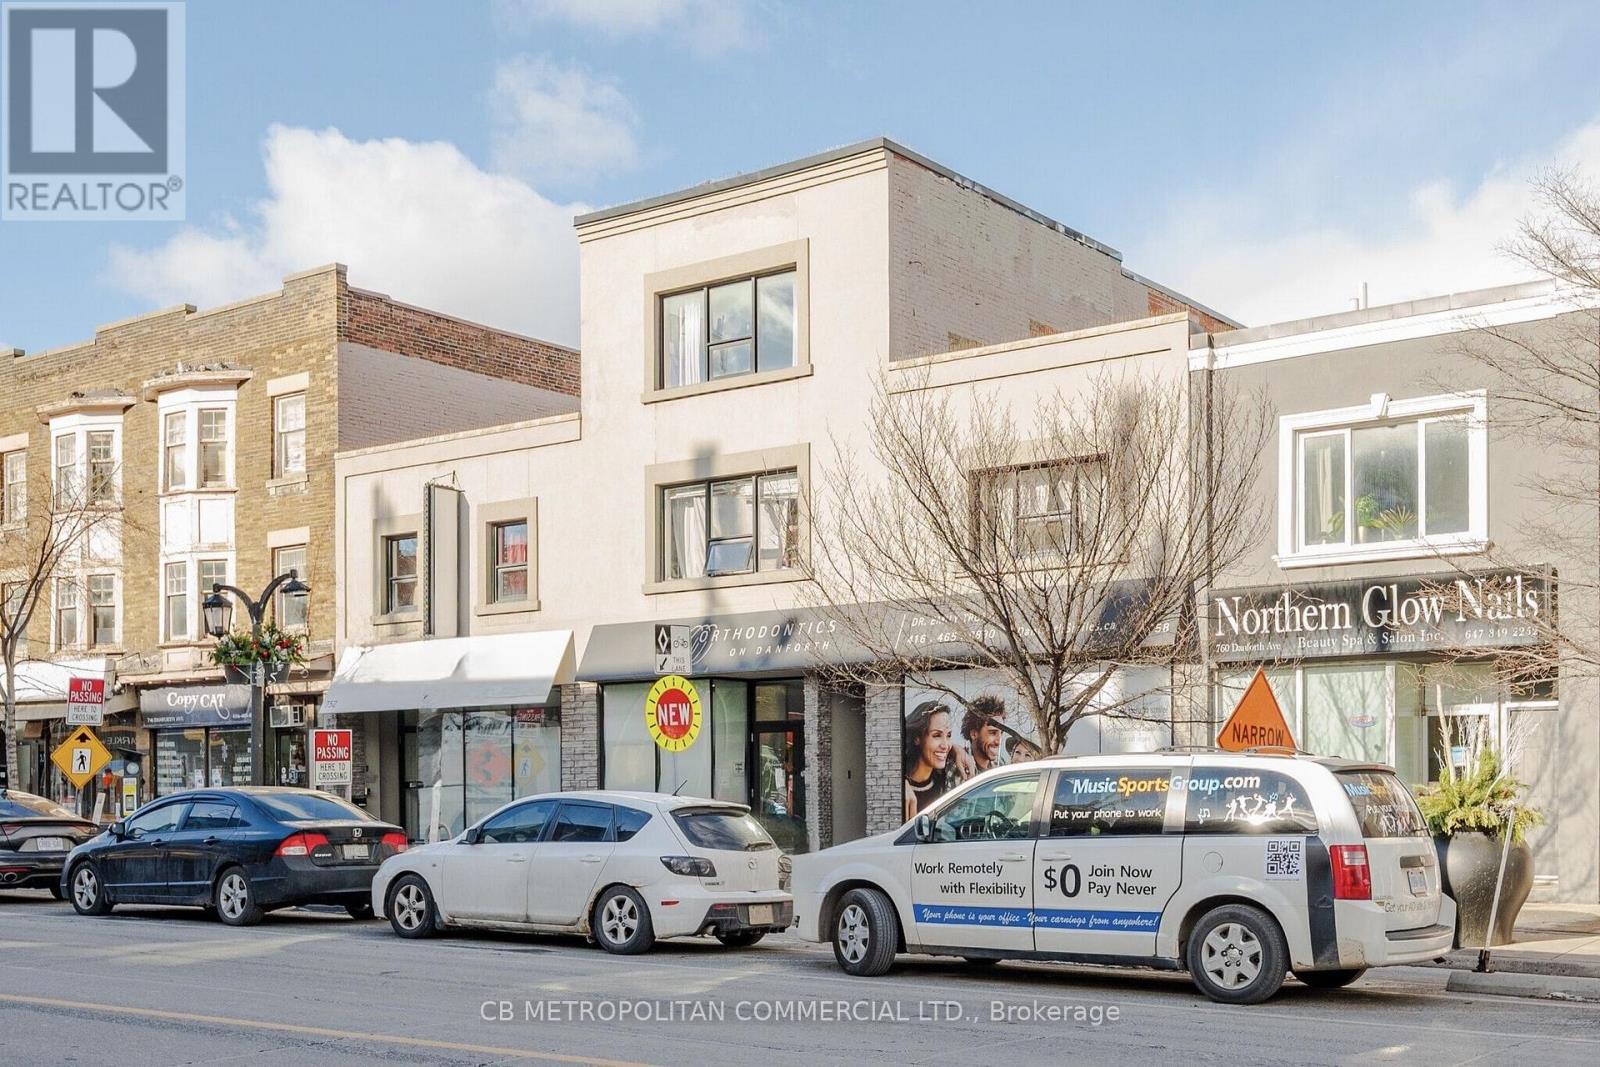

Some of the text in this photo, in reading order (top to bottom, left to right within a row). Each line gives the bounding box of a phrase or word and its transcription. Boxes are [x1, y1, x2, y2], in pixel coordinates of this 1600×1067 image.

[1215, 575, 1539, 637] Northern Glow Nails
[699, 620, 837, 643] ORTHODONTICS
[937, 632, 957, 641] 465
[1297, 630, 1444, 650] Beauty Spa & Salon Inc.
[729, 642, 830, 657] ON DANFORTH
[1215, 643, 1230, 653] 760
[1231, 642, 1265, 652] Danforth
[671, 665, 687, 673] LANE
[81, 680, 93, 691] NO
[70, 691, 102, 703] PASSING
[167, 692, 200, 714] Copy
[73, 705, 88, 713] HERE
[657, 702, 690, 727] NEW
[72, 713, 97, 721] CROSSING
[327, 733, 338, 746] NO
[1232, 722, 1284, 747] NARROW
[316, 746, 349, 759] PASSING
[320, 763, 346, 771] HERE TO
[318, 772, 347, 781] CROSSING
[1072, 775, 1260, 797] MusicSportsGroup.com
[1053, 808, 1162, 821] Put your phone to work
[914, 862, 1004, 877] Work Remotely
[1088, 864, 1153, 878] Join Now
[1043, 863, 1082, 898] $0
[940, 882, 1026, 898] with Flexibility
[1088, 881, 1157, 898] Pay Never
[921, 907, 942, 922] Your
[943, 908, 966, 922] phone
[968, 911, 976, 920] is
[978, 913, 996, 923] your
[998, 912, 1020, 925] office
[1050, 915, 1086, 927] earnings
[1088, 914, 1109, 927] from
[1112, 915, 1159, 928] anywhere!
